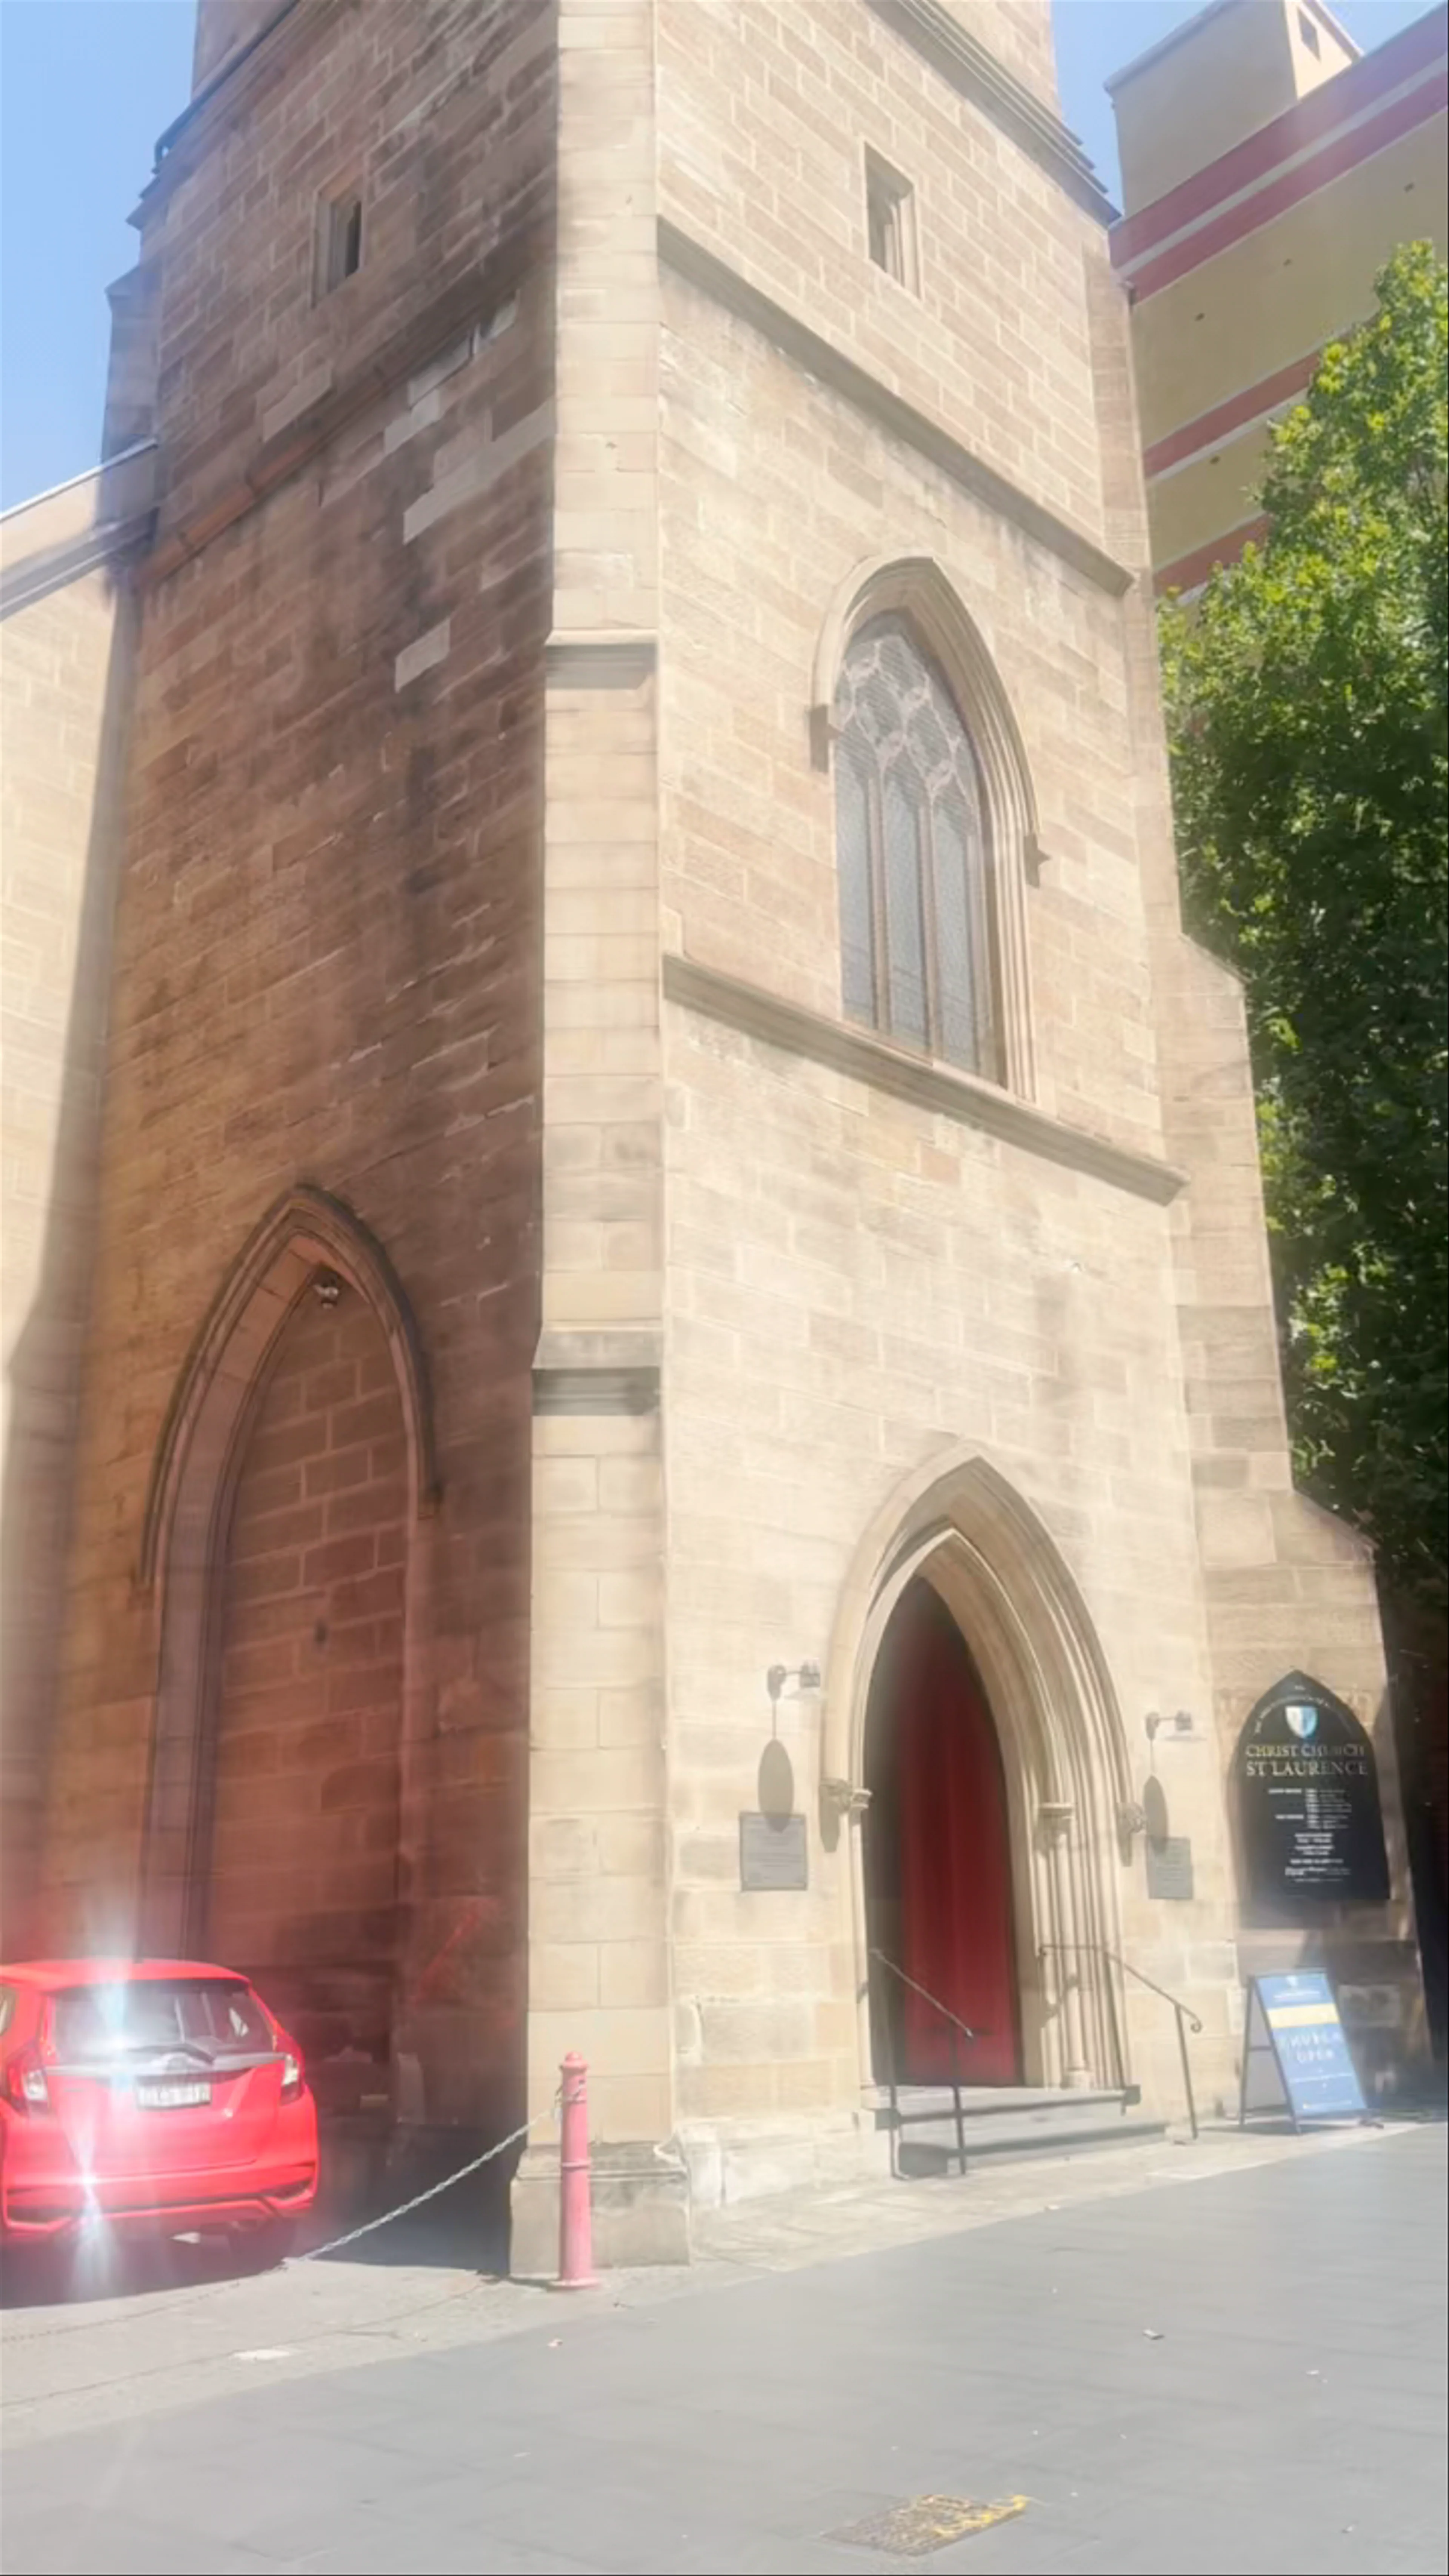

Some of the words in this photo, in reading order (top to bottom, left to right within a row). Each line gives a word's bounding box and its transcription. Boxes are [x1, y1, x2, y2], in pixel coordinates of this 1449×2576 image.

[1245, 1743, 1298, 1757] CHRIST
[1246, 1761, 1264, 1776] ST
[1271, 1760, 1368, 1776] LAURENCE
